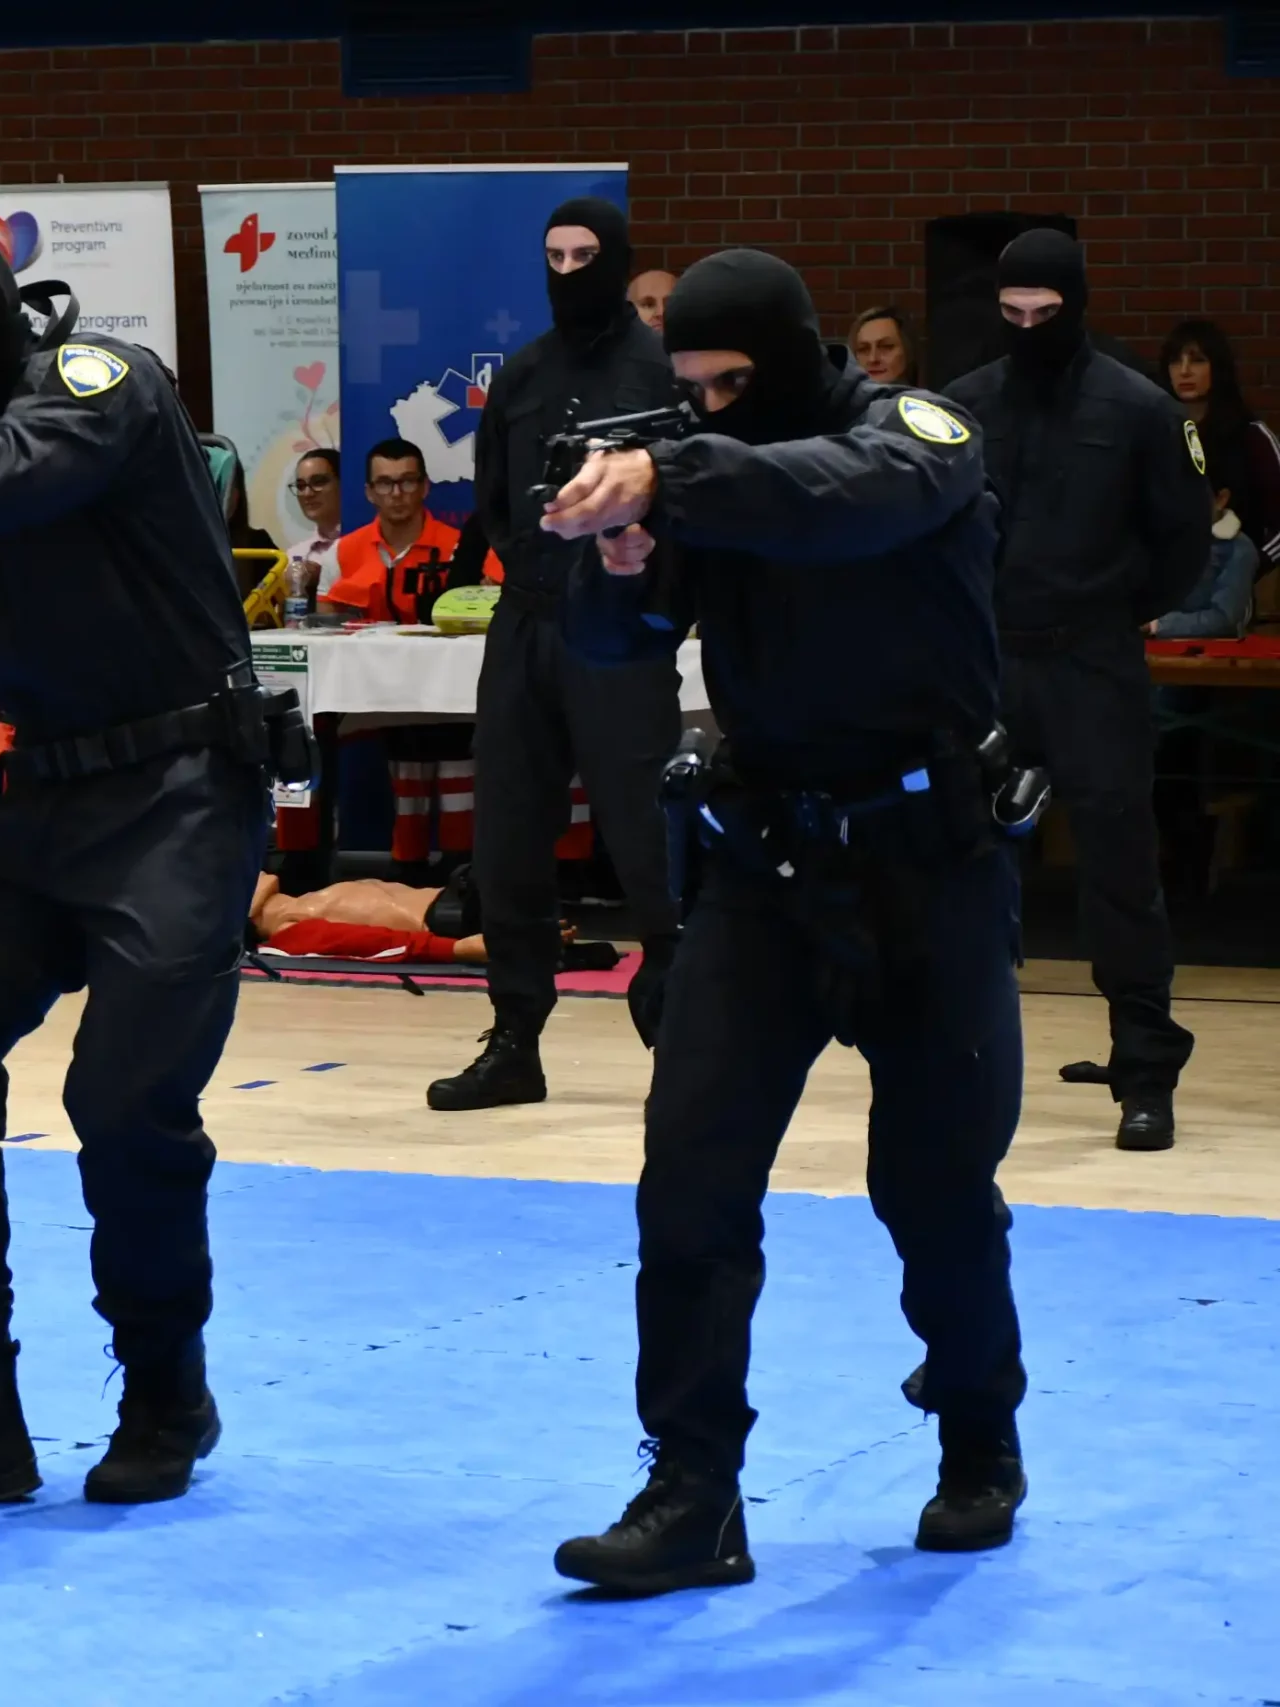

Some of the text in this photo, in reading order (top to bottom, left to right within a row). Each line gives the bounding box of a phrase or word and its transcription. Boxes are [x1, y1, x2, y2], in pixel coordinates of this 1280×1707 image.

[51, 221, 123, 233] Preventivni
[287, 227, 328, 241] zavod
[52, 240, 106, 253] program
[79, 314, 148, 332] program
